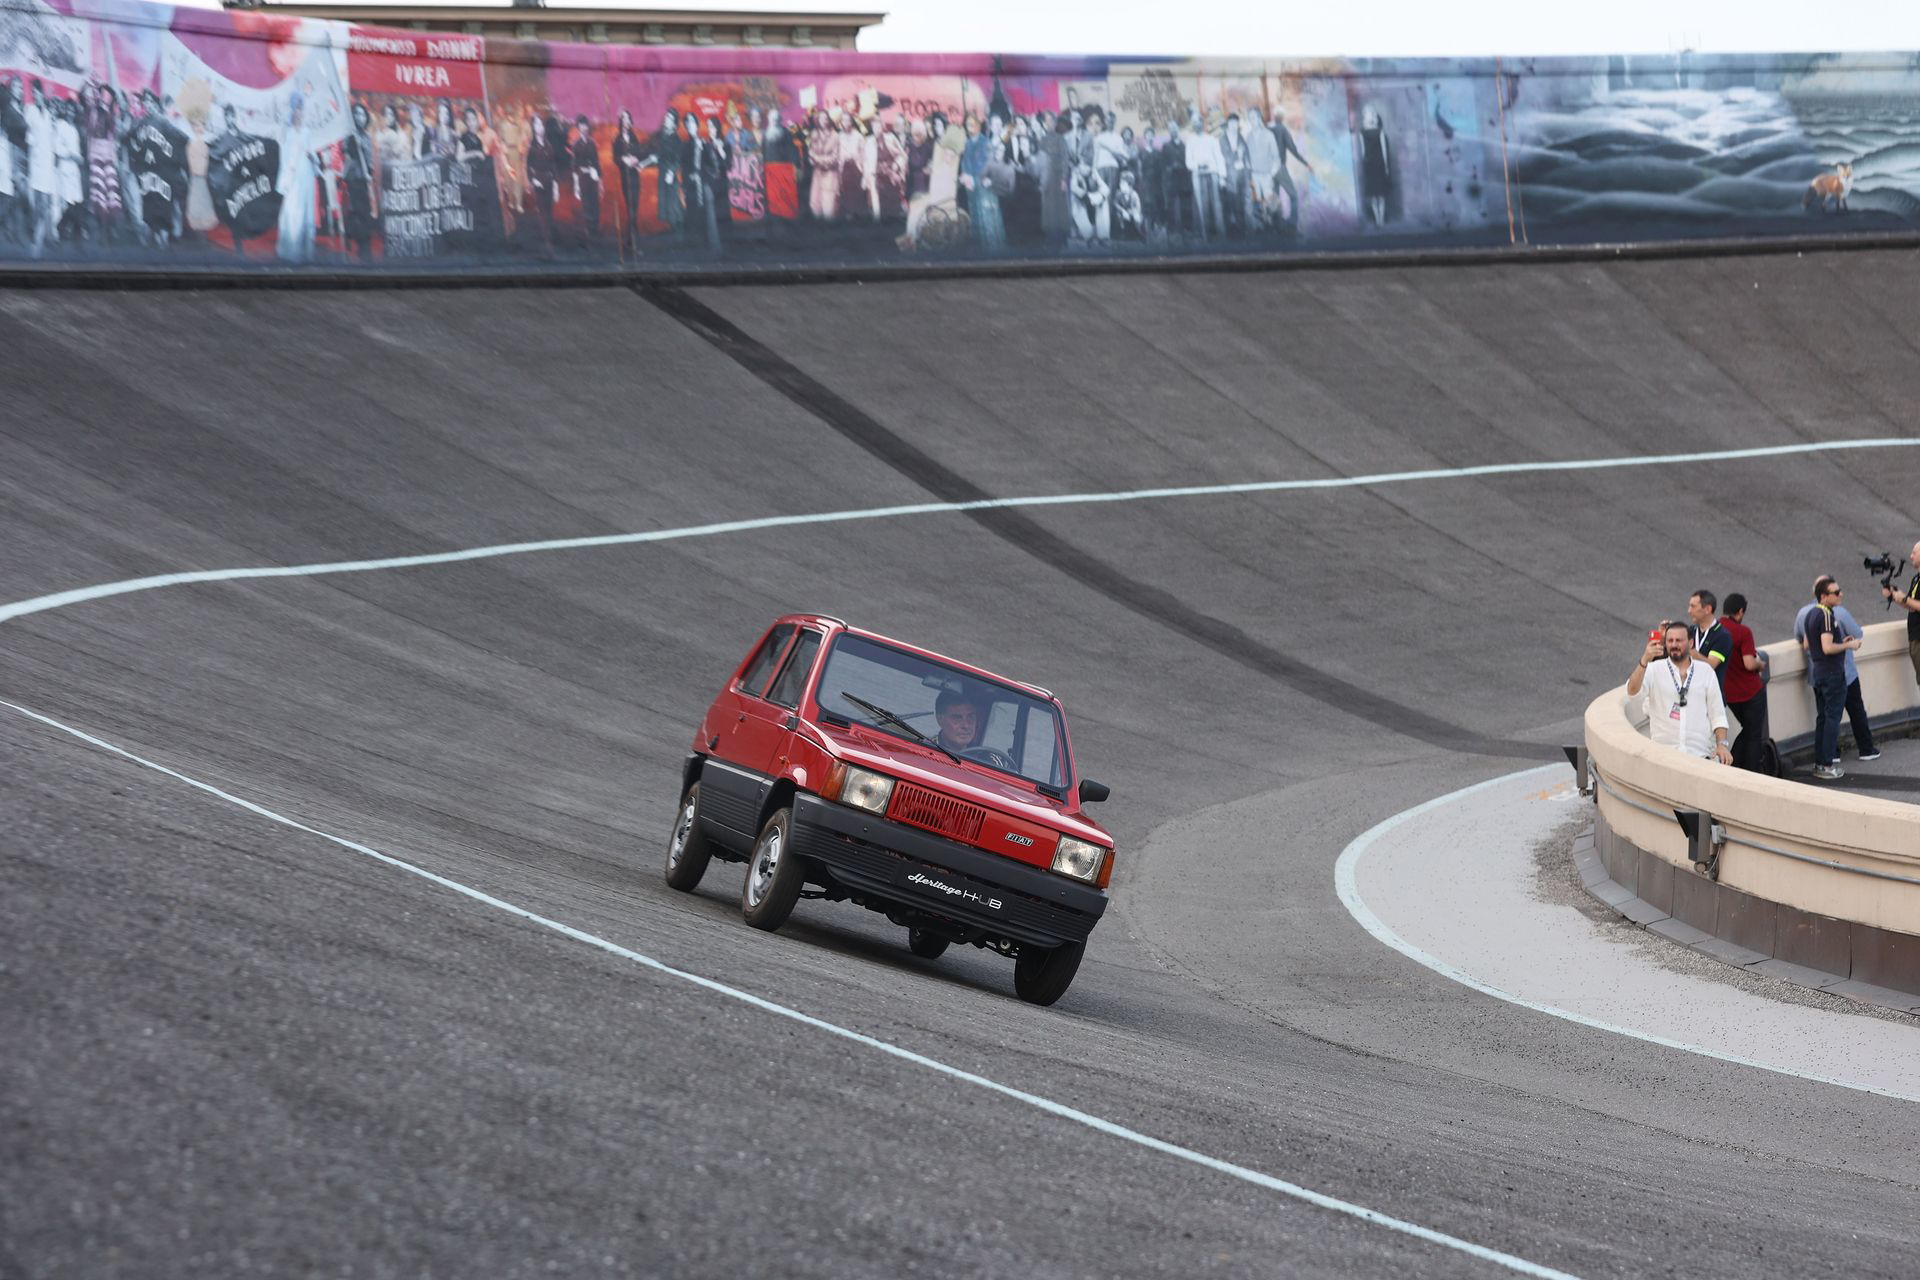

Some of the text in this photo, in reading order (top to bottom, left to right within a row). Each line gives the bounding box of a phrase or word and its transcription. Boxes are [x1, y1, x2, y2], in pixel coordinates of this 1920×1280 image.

[426, 37, 479, 61] DONNE
[396, 63, 450, 87] IVREA
[1006, 833, 1033, 846] FIAT
[908, 873, 1002, 910] Heritage HUB
